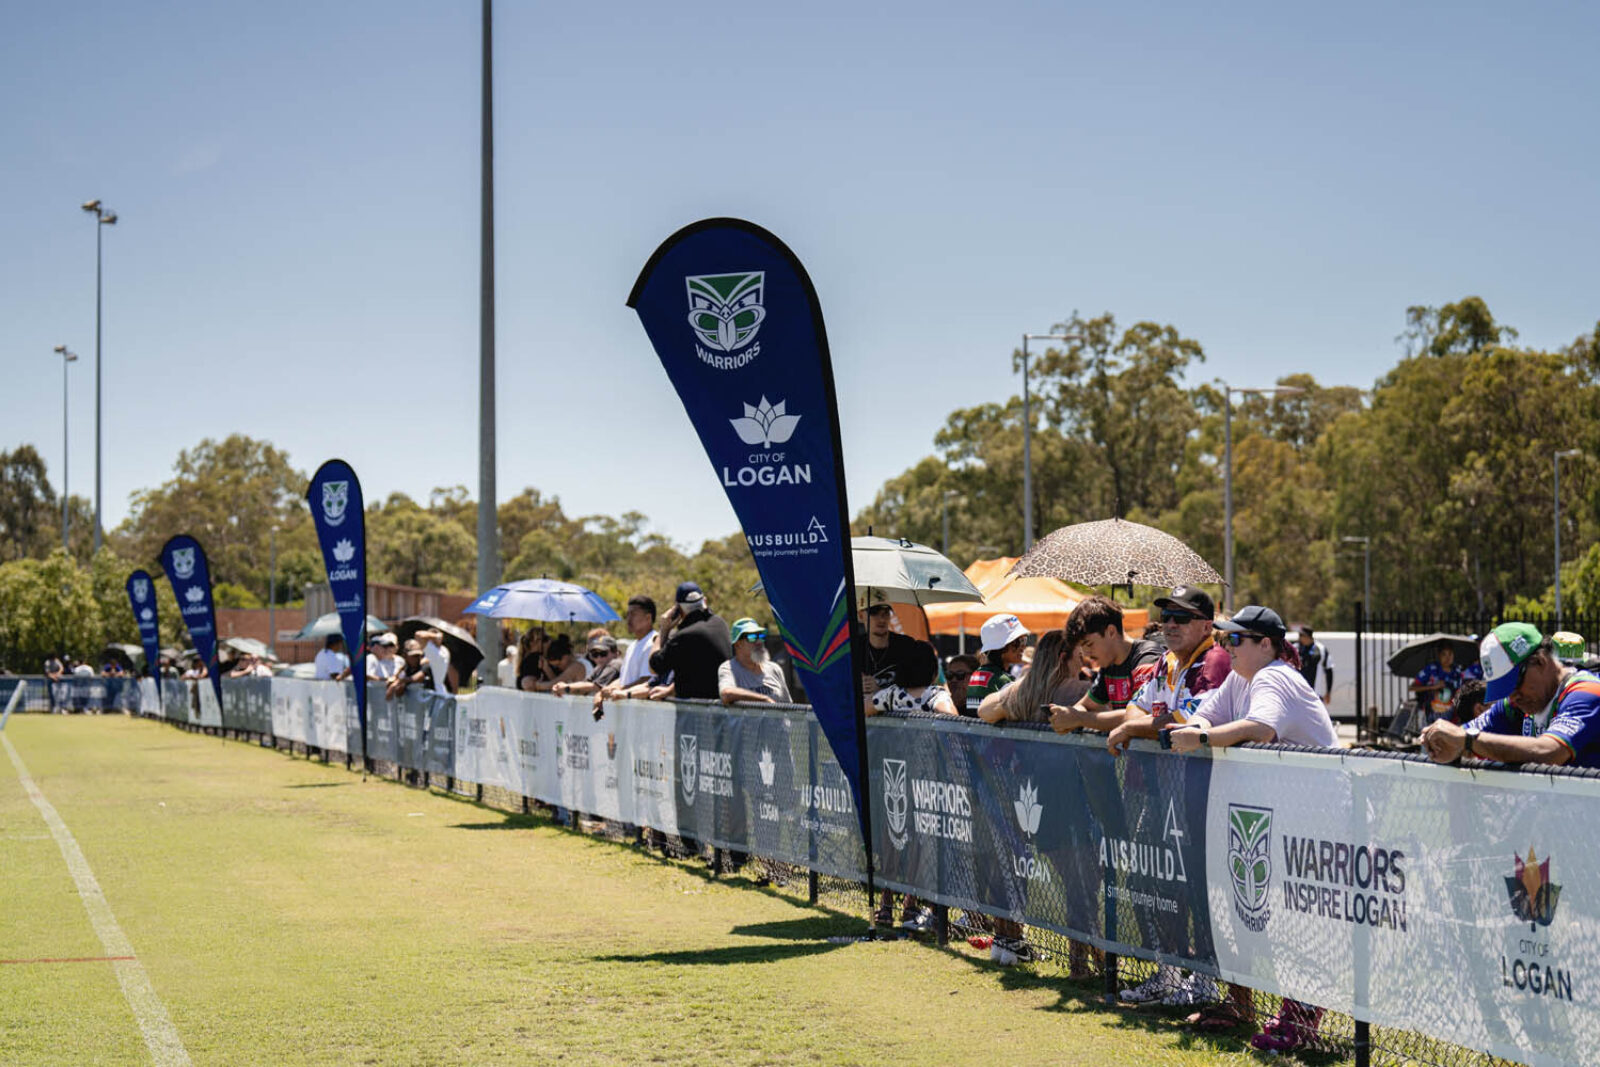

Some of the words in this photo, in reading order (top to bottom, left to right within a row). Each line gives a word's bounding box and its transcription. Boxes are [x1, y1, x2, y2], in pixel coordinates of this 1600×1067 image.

[695, 341, 761, 370] WARRIORS
[748, 453, 770, 464] CITY
[772, 452, 786, 463] OF
[723, 464, 811, 487] LOGAN
[773, 548, 798, 557] journey
[799, 547, 819, 555] home
[330, 569, 357, 580] LOGAN
[760, 803, 780, 822] LOGAN
[911, 779, 972, 817] WARRIORS
[913, 811, 942, 837] INSPIRE
[942, 815, 973, 843] LOGAN
[1013, 854, 1051, 883] LOGAN
[1099, 836, 1175, 881] AUSBUILD
[1283, 834, 1406, 894] WARRIORS
[1233, 895, 1271, 933] WARRIORS
[1283, 880, 1342, 920] INSPIRE
[1344, 891, 1407, 932] LOGAN
[1502, 955, 1572, 1001] LOGAN
